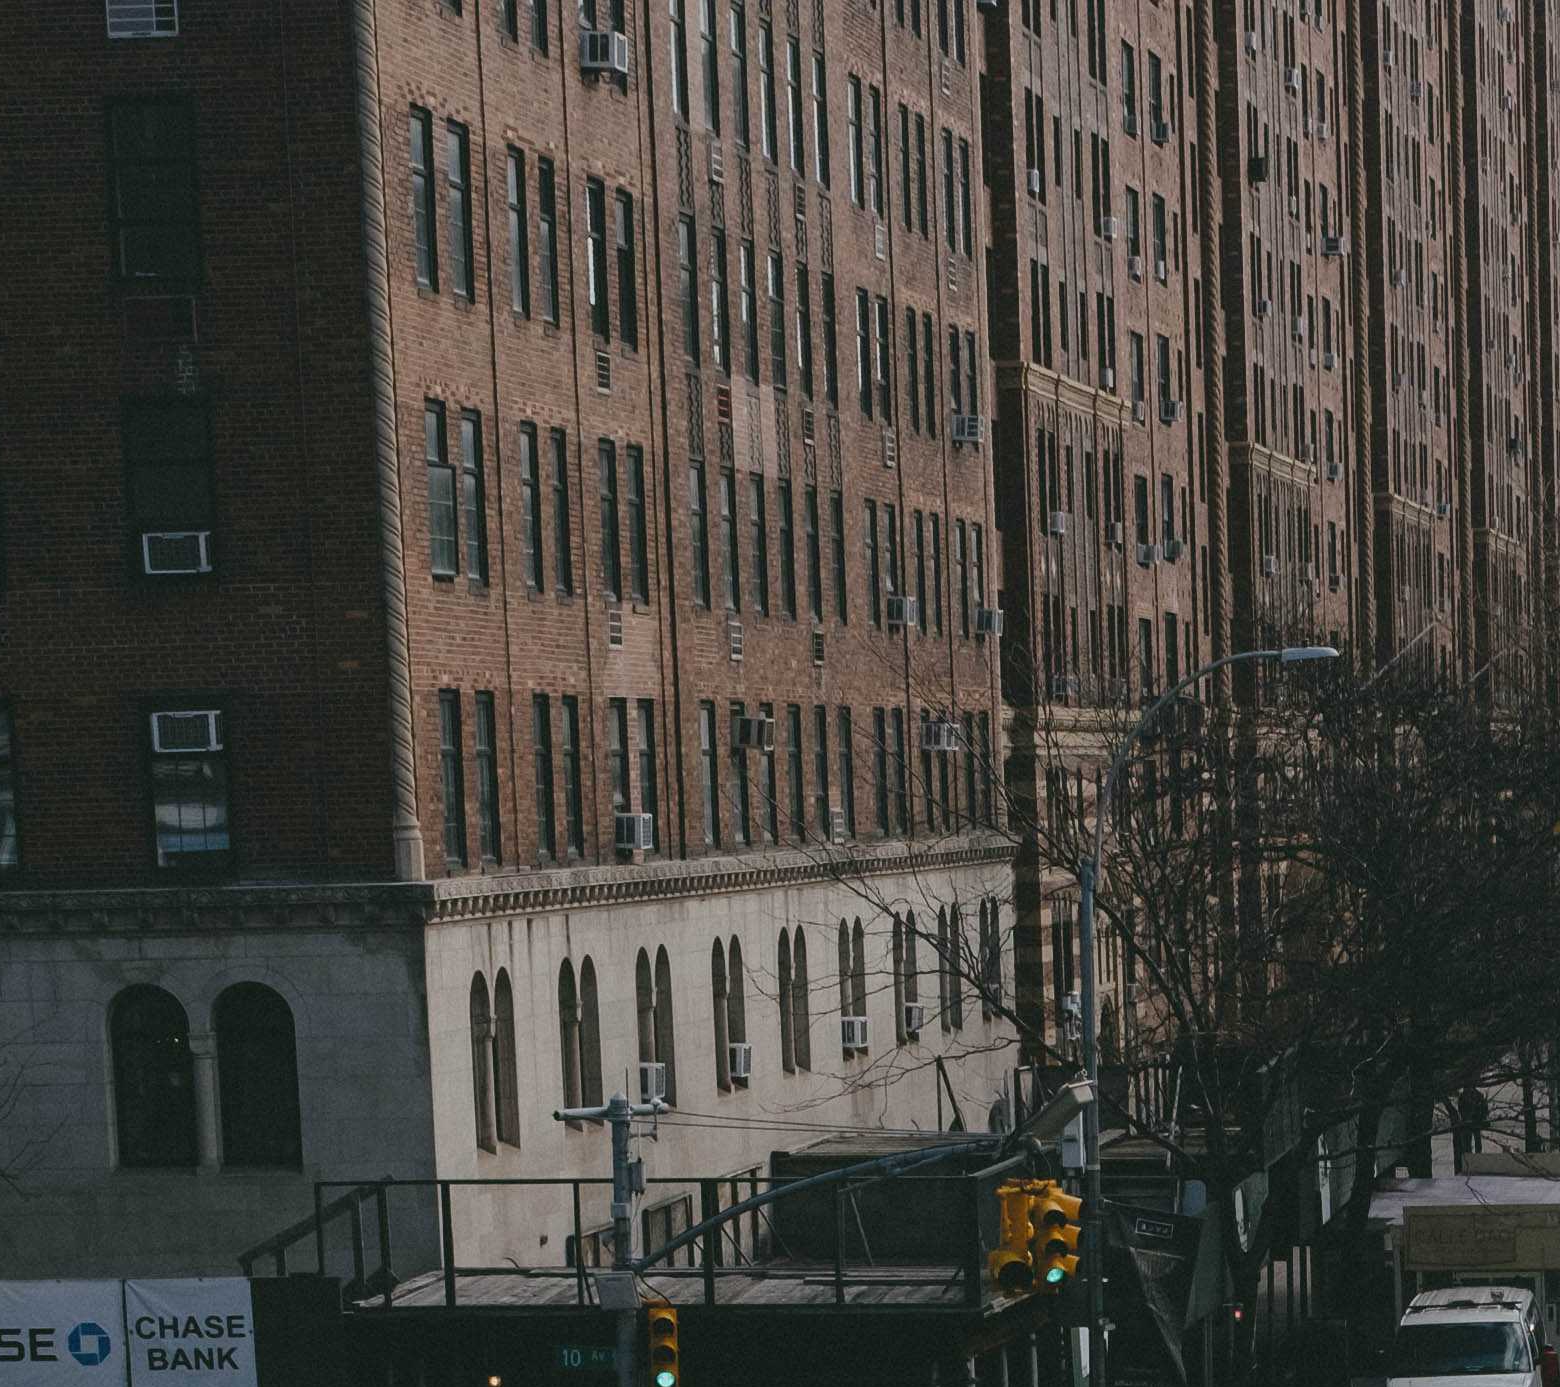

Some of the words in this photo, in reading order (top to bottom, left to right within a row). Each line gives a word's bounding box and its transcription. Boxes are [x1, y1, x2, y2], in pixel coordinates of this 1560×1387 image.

[135, 1315, 246, 1339] CHASE
[147, 1347, 240, 1371] BANK
[561, 1349, 582, 1367] 10
